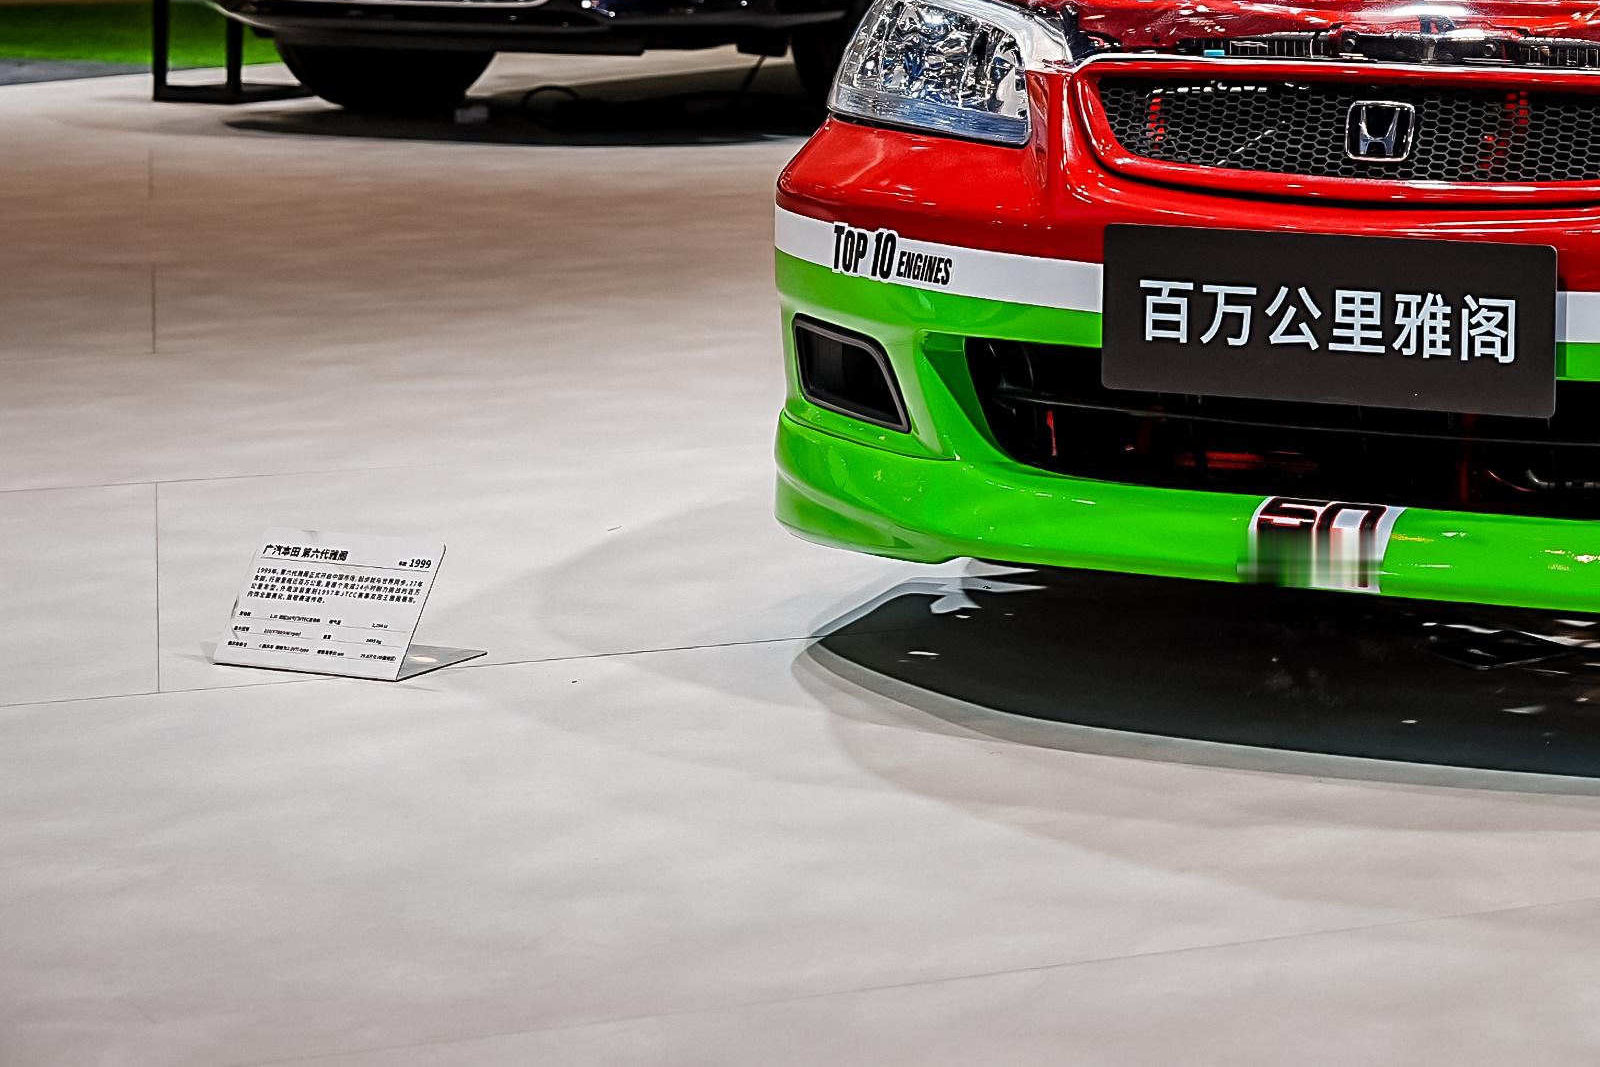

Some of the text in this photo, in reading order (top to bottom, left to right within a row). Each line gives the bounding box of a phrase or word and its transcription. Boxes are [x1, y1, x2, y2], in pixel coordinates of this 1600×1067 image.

[834, 225, 953, 286] TOP 10 ENGINES
[1139, 280, 1518, 365] 百万公里雅阁
[263, 543, 301, 558] 广汽本田
[301, 546, 349, 563] 第六代雅阁
[409, 558, 432, 570] 1999
